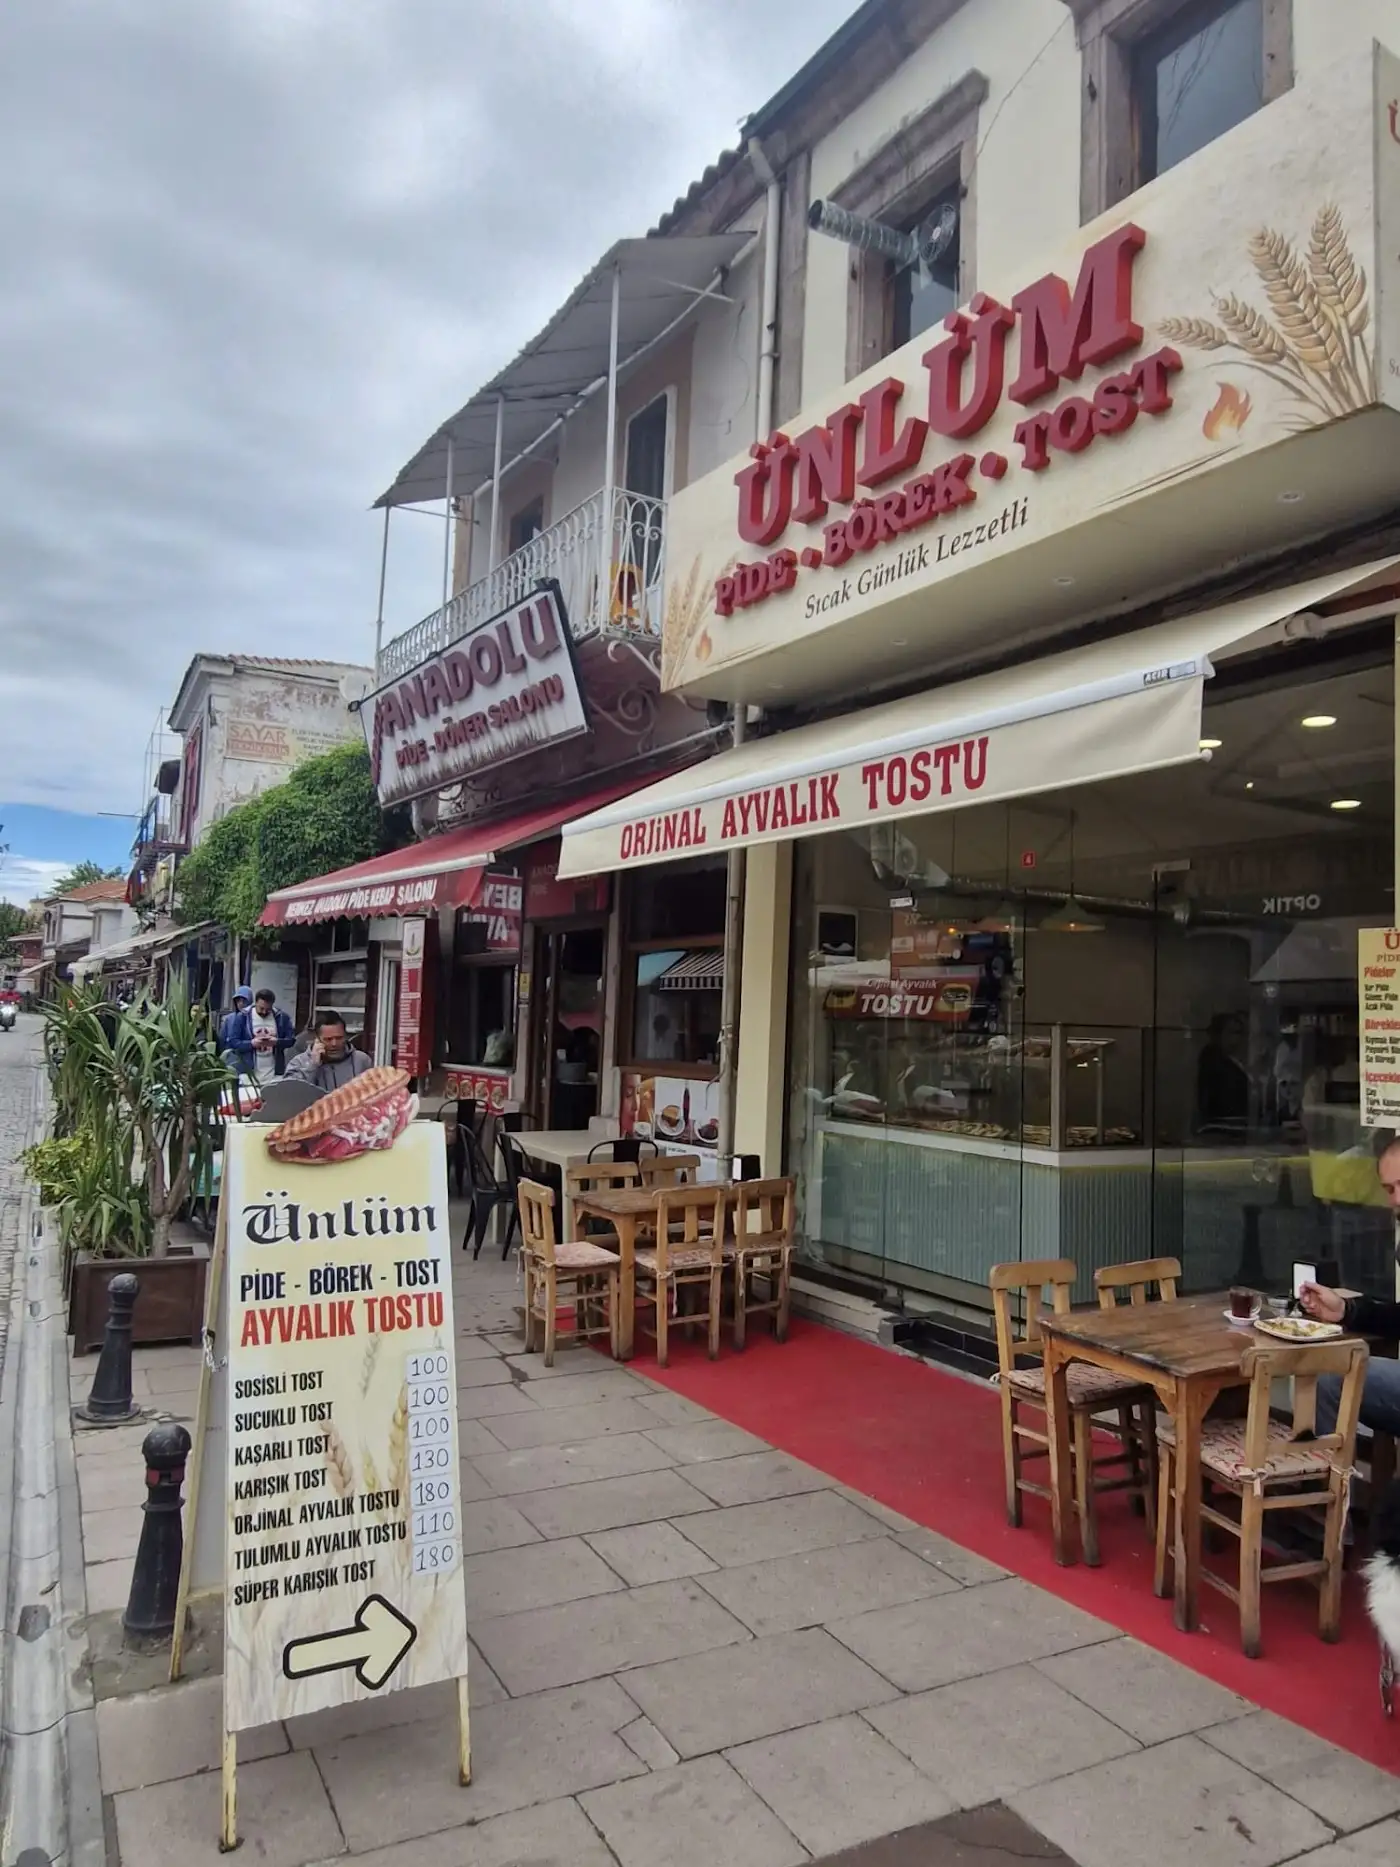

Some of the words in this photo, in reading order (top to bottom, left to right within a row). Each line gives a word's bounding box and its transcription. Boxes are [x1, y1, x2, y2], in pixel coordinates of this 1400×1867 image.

[734, 222, 1146, 546] ÜNLÜM
[715, 548, 796, 615] PİDE
[823, 453, 977, 568] BÖREK
[1015, 346, 1183, 470] TOST
[805, 577, 851, 619] Sıcak
[858, 544, 928, 595] Günlük
[936, 497, 1029, 562] Lezzetli
[381, 596, 562, 736] ANADOLU
[229, 722, 287, 744] SAYAR
[395, 740, 429, 769] PİDE
[434, 716, 489, 754] DÖNER
[488, 673, 565, 729] SALONU
[721, 773, 840, 839] AYVALIK
[862, 737, 990, 810] TOSTU
[397, 878, 438, 906] SALONU
[861, 994, 934, 1016] TOSTU
[242, 1190, 437, 1245] Ünlüm
[240, 1268, 286, 1302] PİDE
[310, 1262, 373, 1296] BÖREK
[394, 1259, 441, 1287] TOST
[240, 1299, 354, 1347] AYVALIK
[363, 1292, 444, 1334] TOSTU
[411, 1356, 448, 1377] 100
[235, 1371, 287, 1399] SOSİSLİ
[291, 1370, 324, 1392] TOST
[410, 1386, 449, 1408] 100
[235, 1408, 296, 1432] SUCUKLU
[300, 1402, 334, 1423] TOST
[411, 1417, 449, 1438] 100
[235, 1440, 293, 1470] KAŞARLI
[297, 1434, 331, 1456] TOST
[412, 1448, 449, 1471] 130
[235, 1473, 290, 1500] KARIŞIK
[294, 1468, 328, 1490] TOST
[415, 1481, 450, 1506] 180
[234, 1507, 294, 1535] ORJİNAL
[299, 1496, 354, 1524] AYVALIK
[359, 1488, 400, 1514] TOSTU
[414, 1512, 454, 1537] 110
[235, 1540, 300, 1570] TULUMLU
[305, 1530, 361, 1557] AYVALIK
[366, 1520, 407, 1545] TOSTU
[415, 1545, 454, 1572] 180
[234, 1579, 279, 1606] SÜPER
[284, 1568, 339, 1595] KARIŞIK
[343, 1560, 376, 1583] TOST
